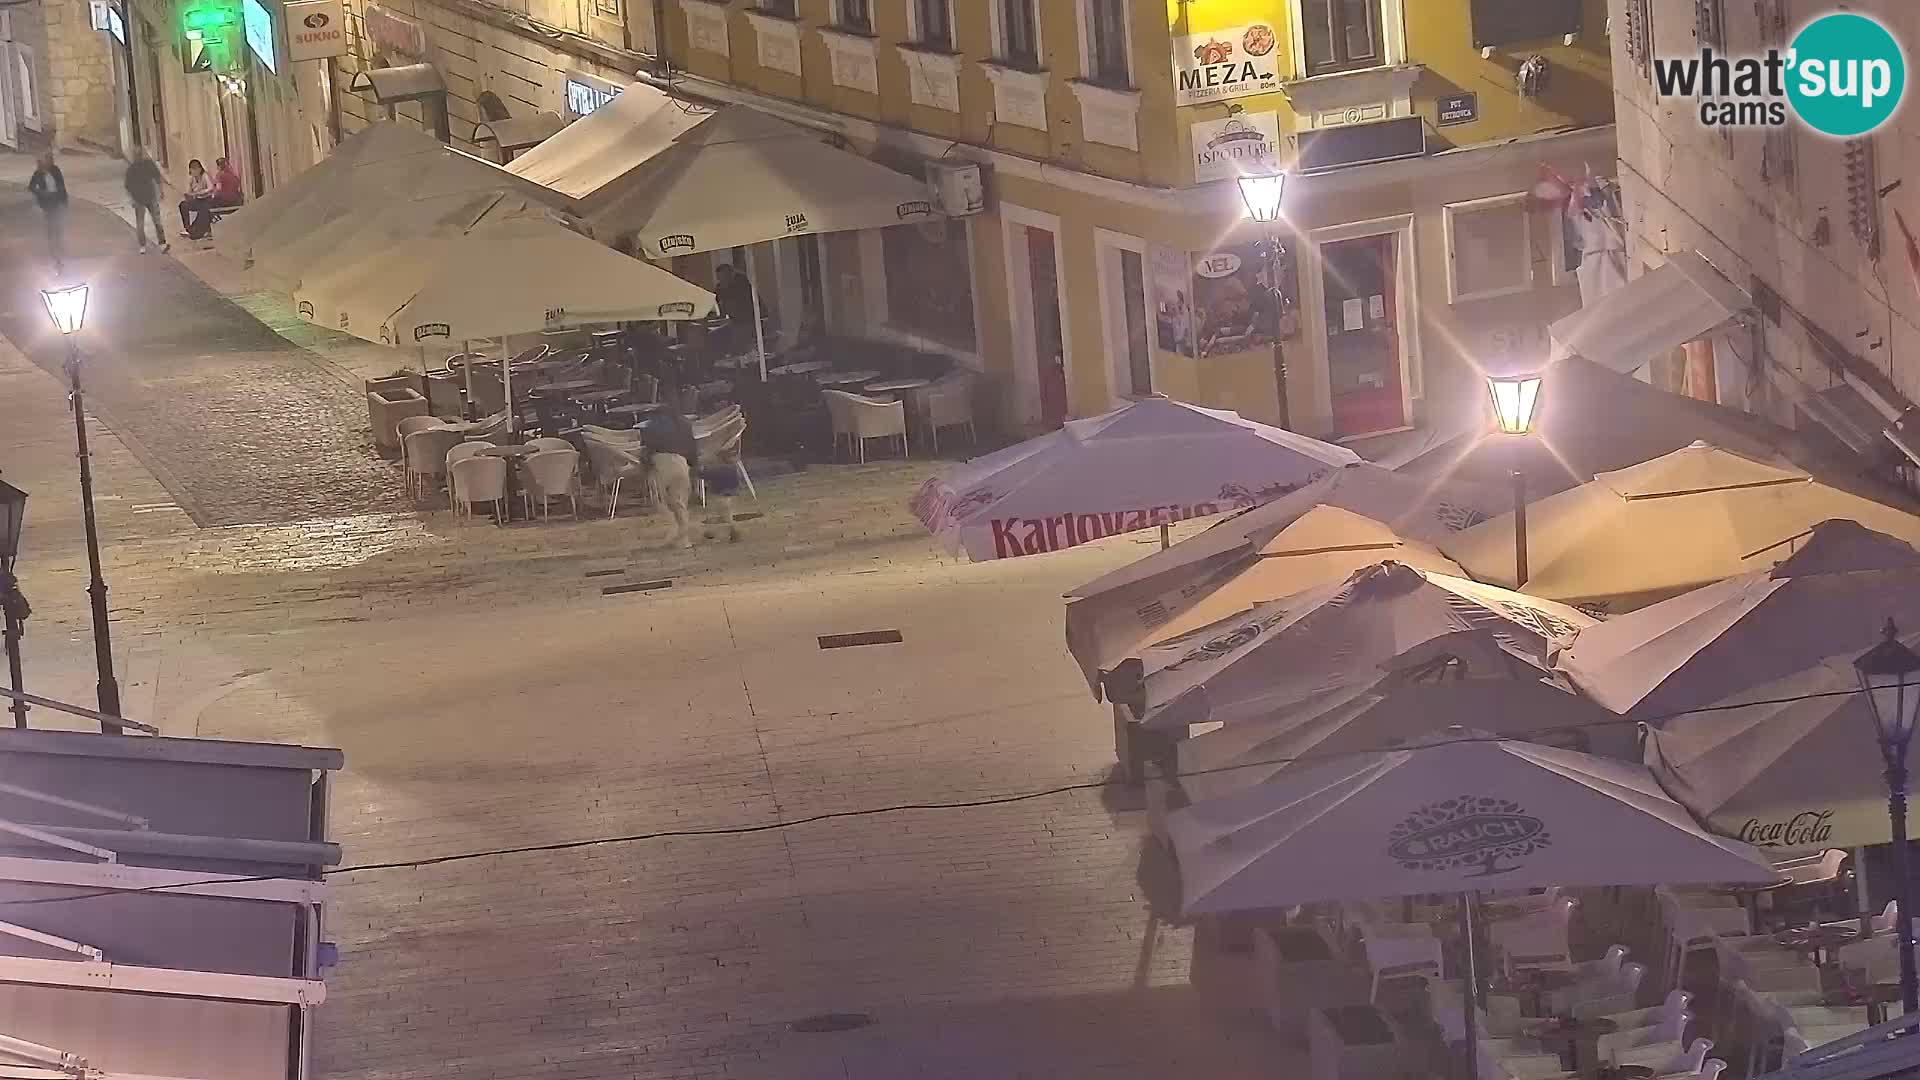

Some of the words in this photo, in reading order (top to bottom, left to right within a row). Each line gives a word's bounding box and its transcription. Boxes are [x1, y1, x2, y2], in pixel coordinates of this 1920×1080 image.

[296, 30, 340, 44] SUKNO
[1179, 61, 1258, 91] MEZA
[1187, 87, 1221, 98] PIZZERIA
[1228, 83, 1249, 93] GRILL
[1260, 82, 1276, 90] 80m
[1450, 100, 1462, 109] PUT
[1198, 146, 1243, 165] ISPOD
[785, 213, 806, 228] ŽUJA
[1430, 819, 1527, 851] RAUCH
[1738, 809, 1835, 847] Coca-Cola
